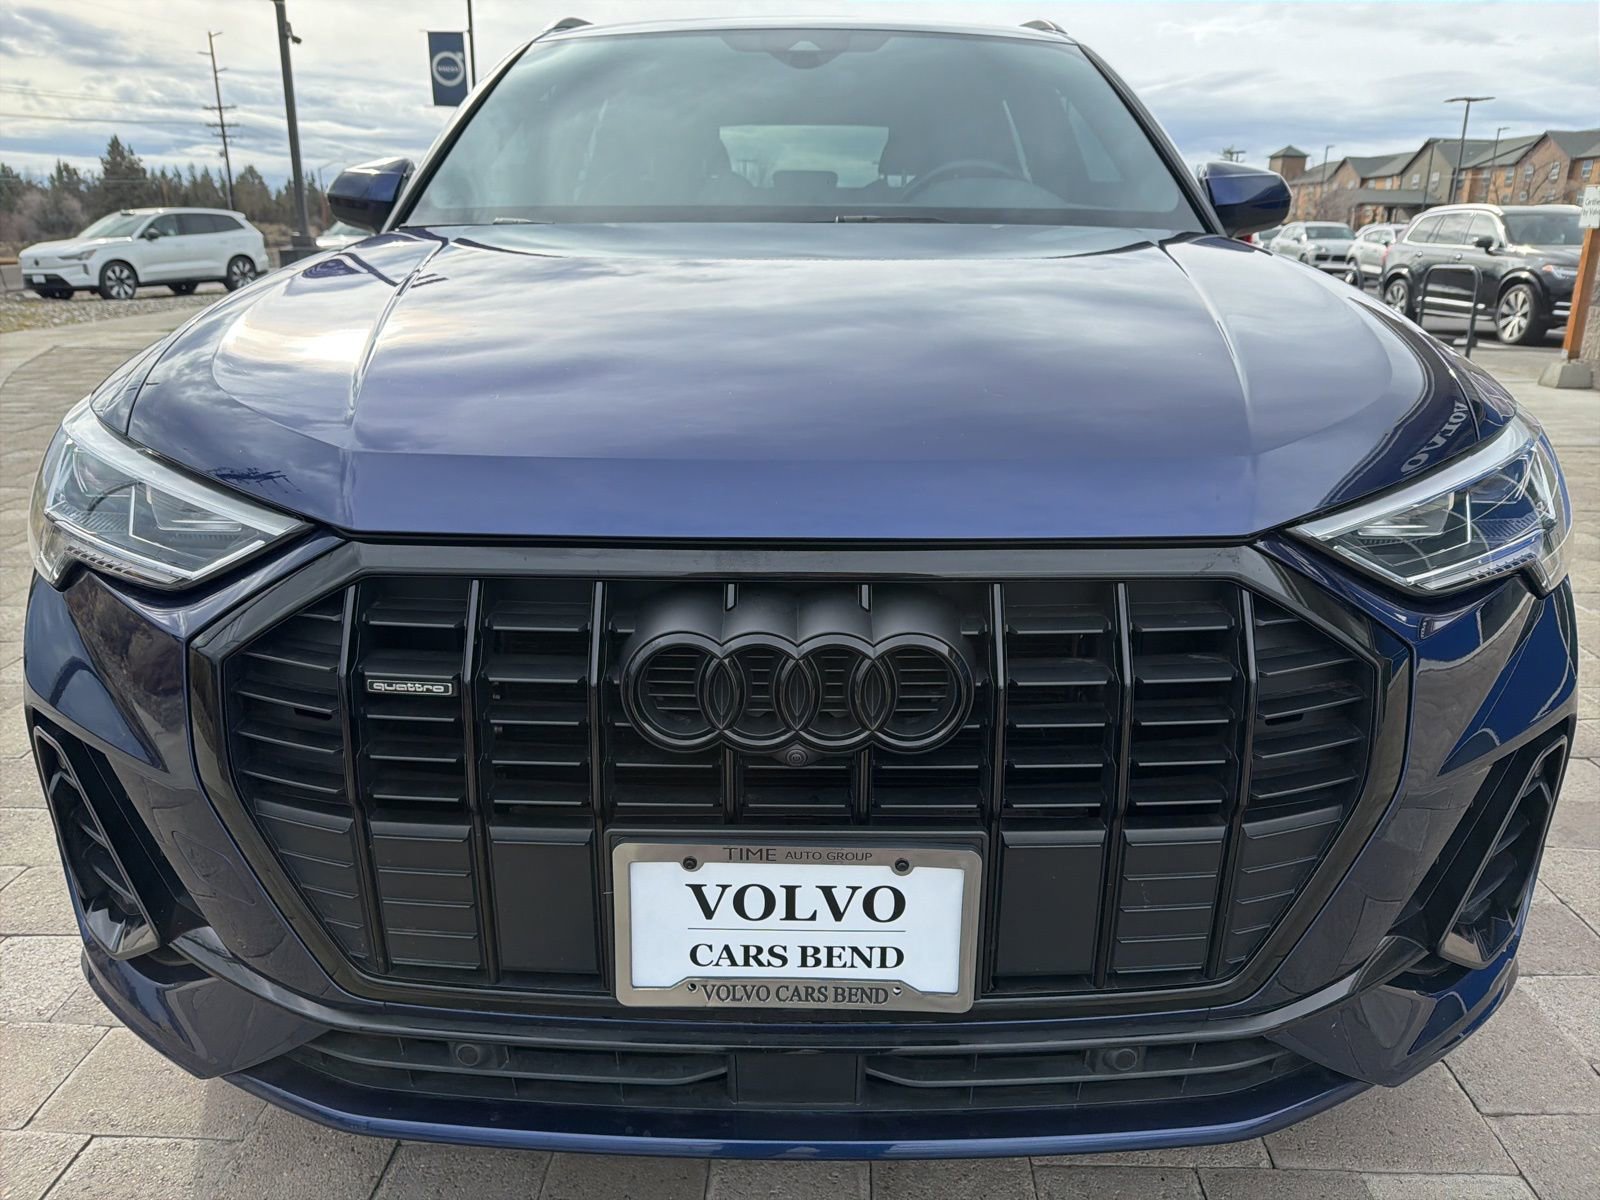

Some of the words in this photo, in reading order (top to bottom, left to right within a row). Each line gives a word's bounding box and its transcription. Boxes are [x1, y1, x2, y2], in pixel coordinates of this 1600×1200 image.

[373, 683, 444, 692] quattro
[723, 847, 776, 861] TIME
[785, 851, 821, 860] AUTO
[827, 852, 872, 861] GROUP
[685, 884, 906, 922] VOLVO
[689, 944, 788, 967] CARS
[797, 946, 904, 968] BEND
[701, 984, 771, 1001] VOLVO
[776, 985, 828, 1003] CARS
[833, 987, 888, 1004] BEND
